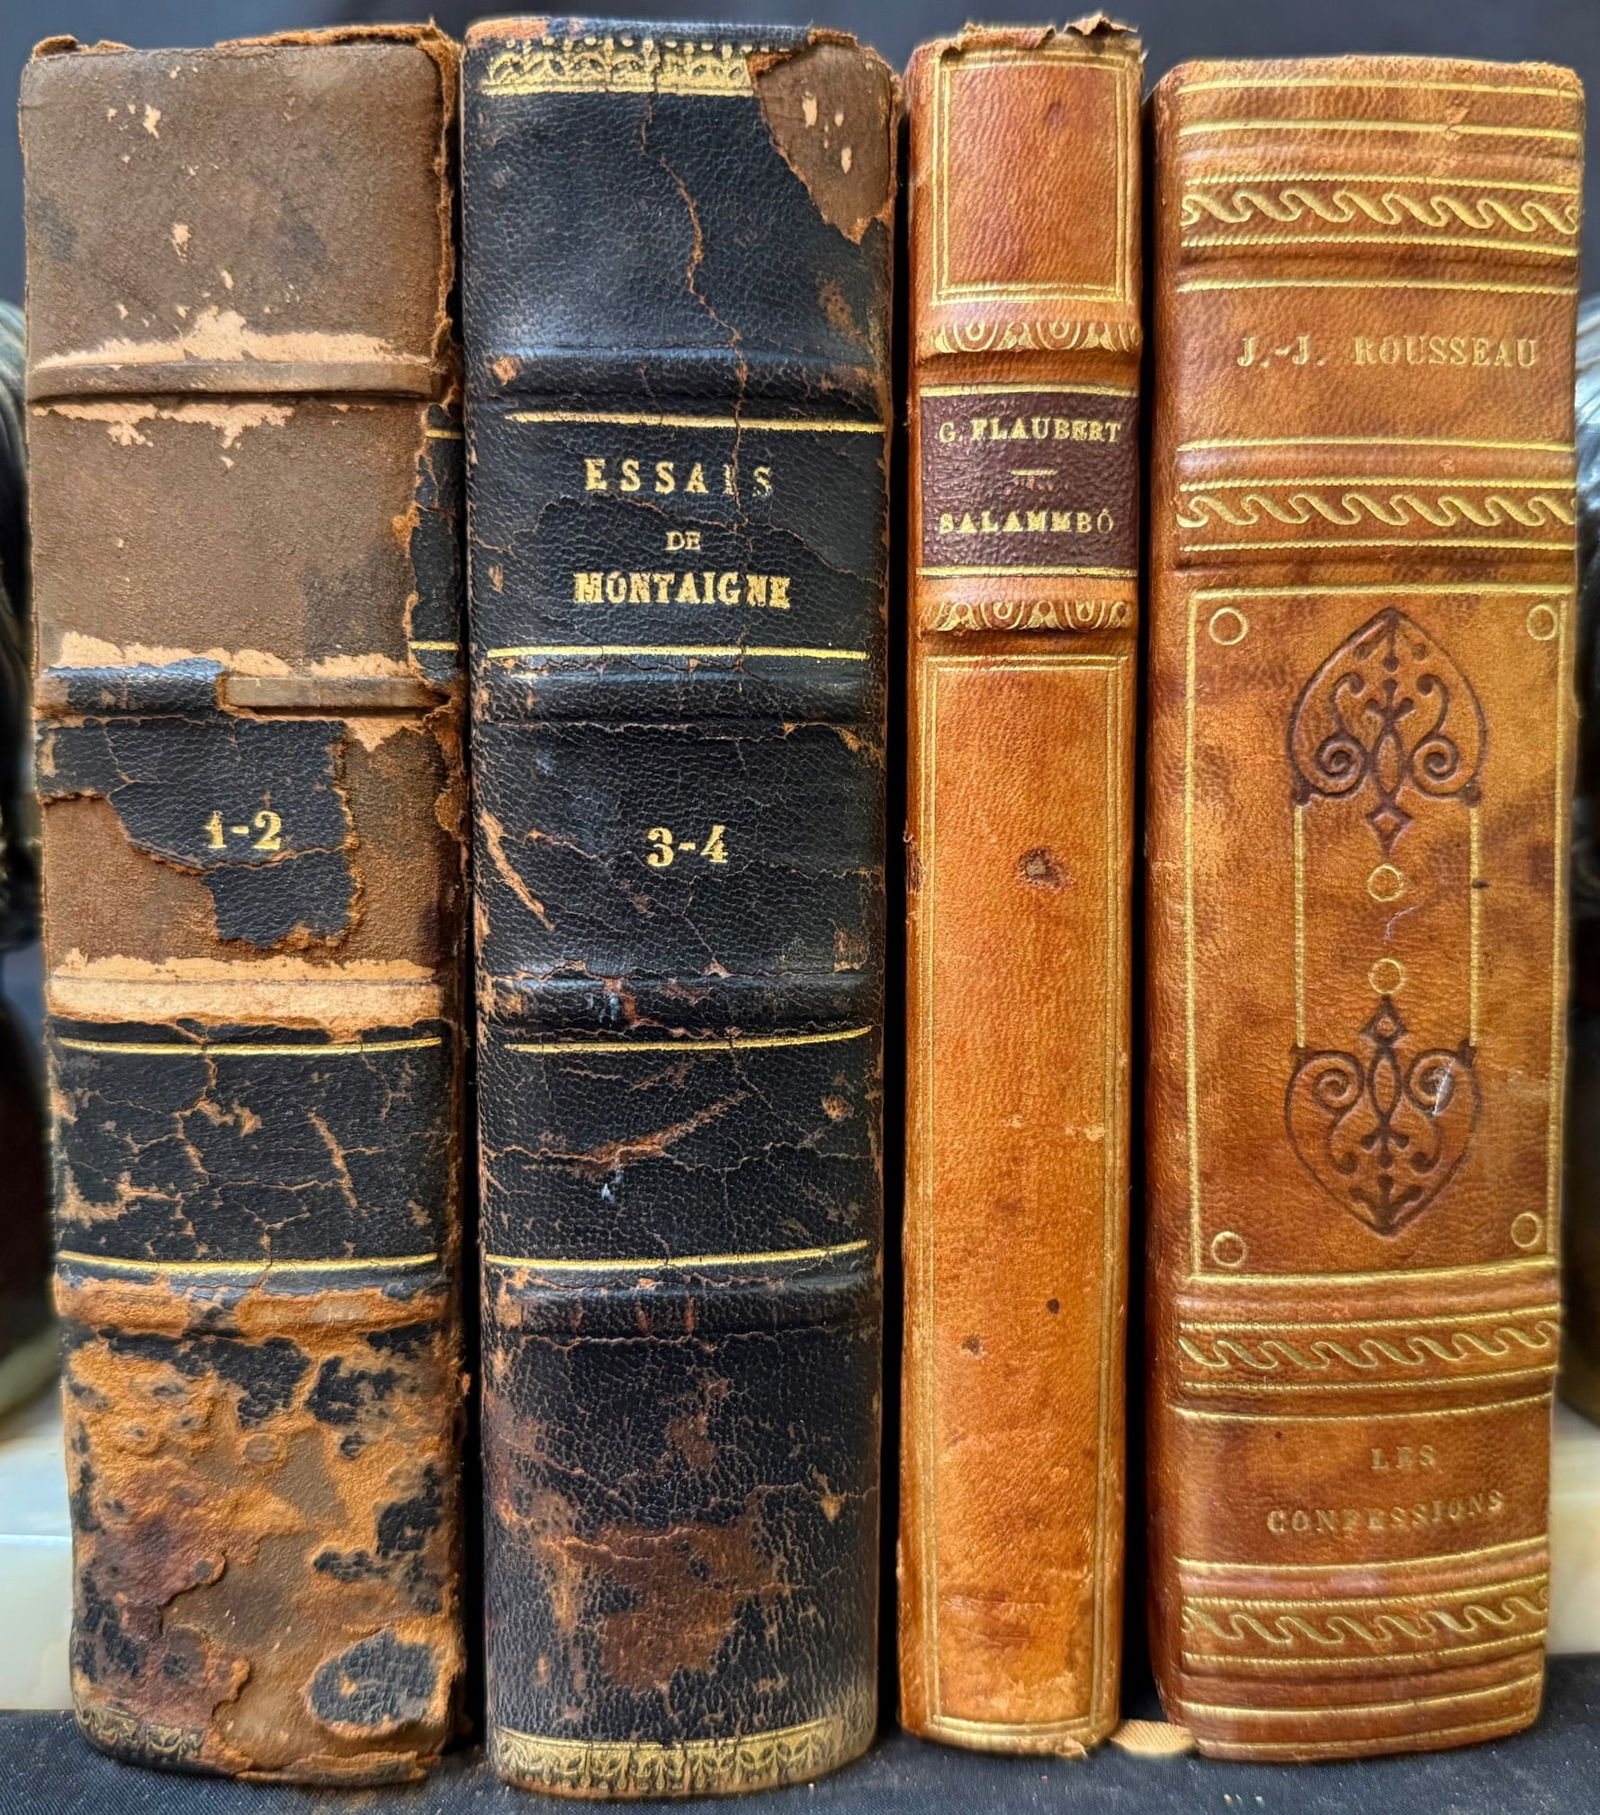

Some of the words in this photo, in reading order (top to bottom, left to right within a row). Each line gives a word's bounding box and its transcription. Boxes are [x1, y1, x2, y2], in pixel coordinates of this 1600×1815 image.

[1236, 334, 1326, 368] J.-J.
[1351, 333, 1539, 368] ROUSSEAU
[939, 421, 964, 443] G.
[970, 417, 1121, 443] FLAUBERT
[584, 458, 774, 498] ESSAIS
[938, 508, 1114, 534] SALAMMBÔ
[665, 530, 701, 551] DE
[572, 571, 791, 609] MONTAIGNE
[203, 810, 282, 851] 1-2
[646, 824, 729, 867] 3-4
[1370, 1444, 1437, 1471] LES
[1266, 1489, 1504, 1534] CONFESSIONS
